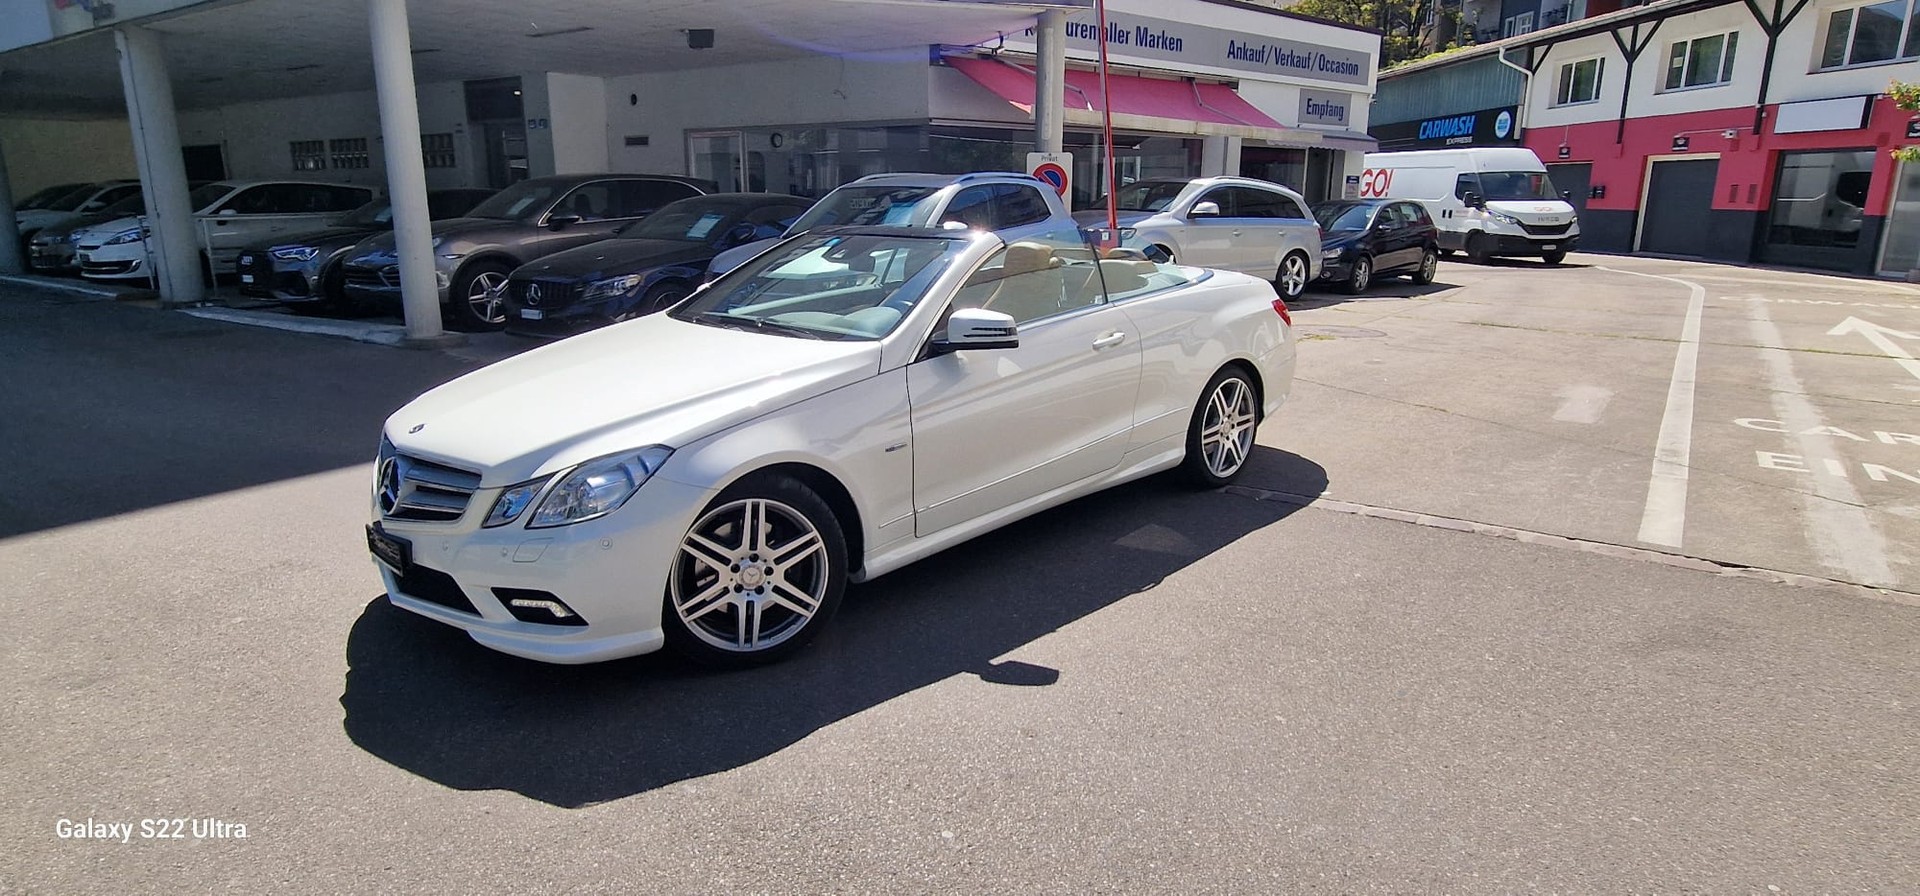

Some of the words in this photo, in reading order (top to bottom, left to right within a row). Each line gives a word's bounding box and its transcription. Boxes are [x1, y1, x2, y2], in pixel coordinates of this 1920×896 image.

[1135, 26, 1183, 52] Marken
[1306, 98, 1344, 121] Empfang
[1419, 115, 1476, 139] CARWASH
[1360, 168, 1394, 197] GO!
